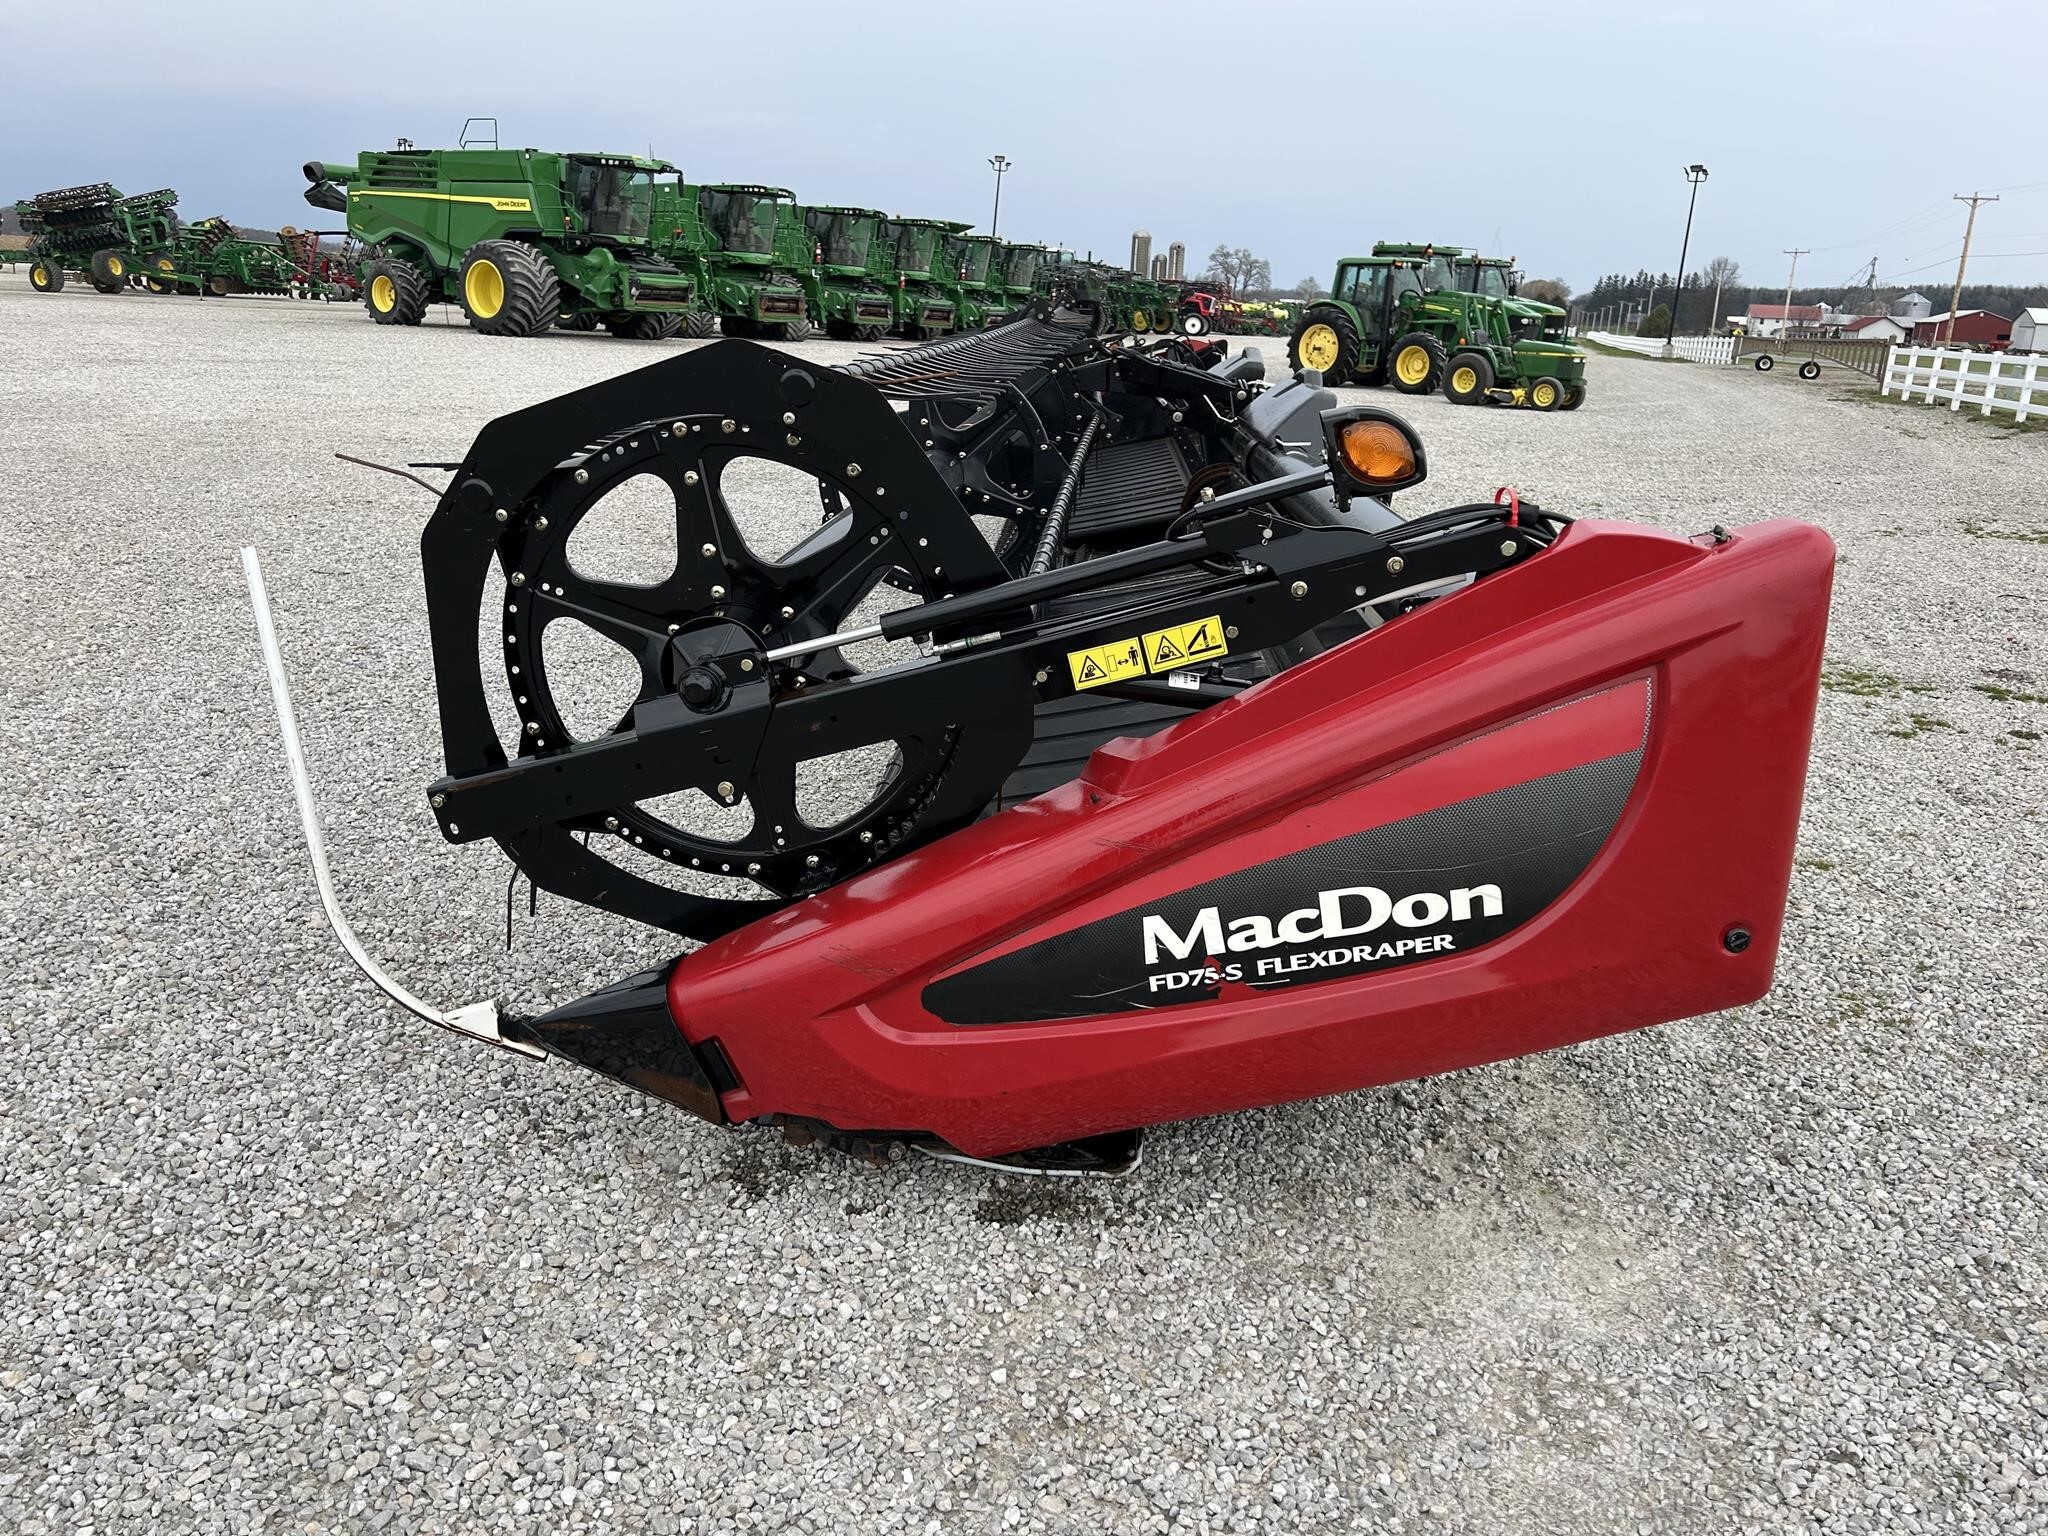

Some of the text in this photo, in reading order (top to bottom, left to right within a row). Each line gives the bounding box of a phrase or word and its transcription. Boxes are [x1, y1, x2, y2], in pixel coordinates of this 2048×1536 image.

[510, 200, 527, 208] DEERE
[1142, 883, 1504, 965] MacDon
[1148, 934, 1456, 993] FD75-S FLEXDRAPER
